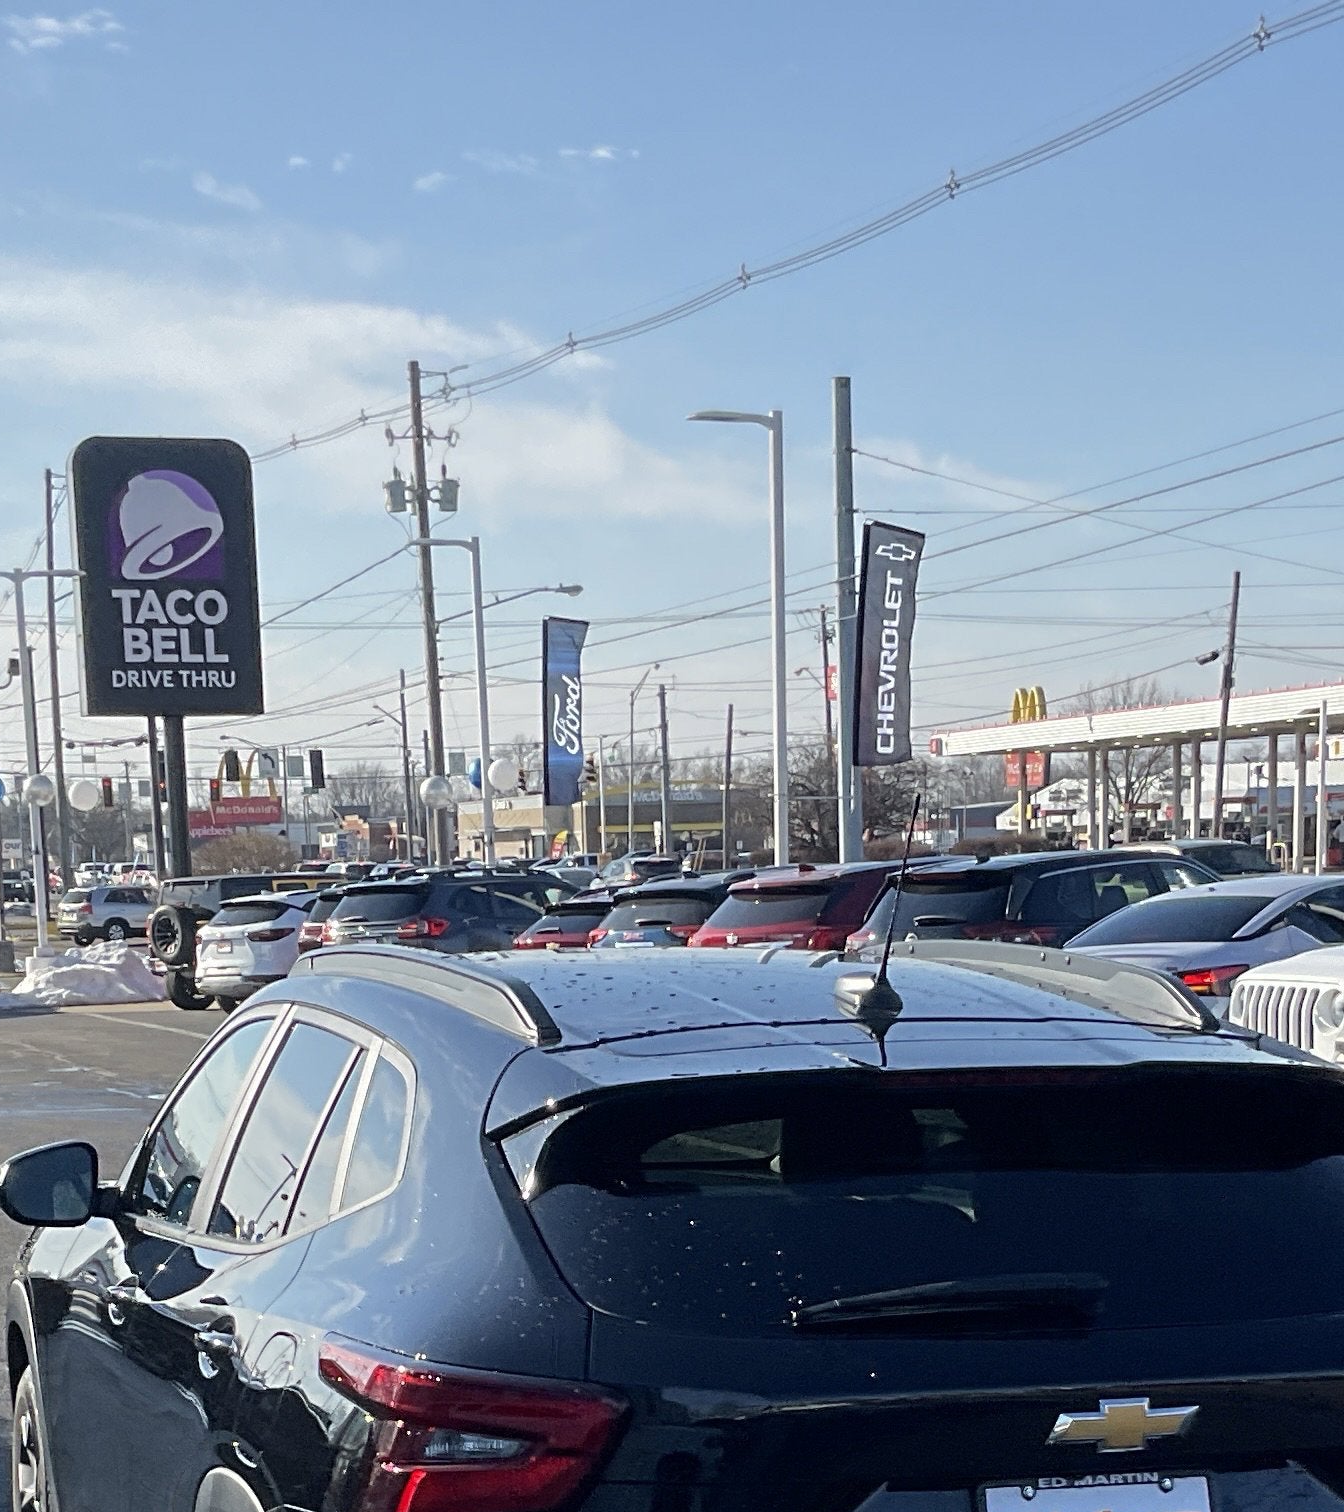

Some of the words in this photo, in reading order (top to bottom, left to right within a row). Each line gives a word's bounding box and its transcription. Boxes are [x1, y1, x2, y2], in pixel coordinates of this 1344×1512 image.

[111, 588, 229, 626] TACO
[122, 627, 229, 664] BELL
[876, 570, 903, 755] CHEVROLET
[111, 669, 174, 688] DRIVE
[178, 669, 236, 688] THRU
[553, 673, 580, 755] Ford
[215, 804, 279, 815] McDonald's
[1038, 1477, 1067, 1489] ED
[1073, 1471, 1159, 1487] MARTIN
